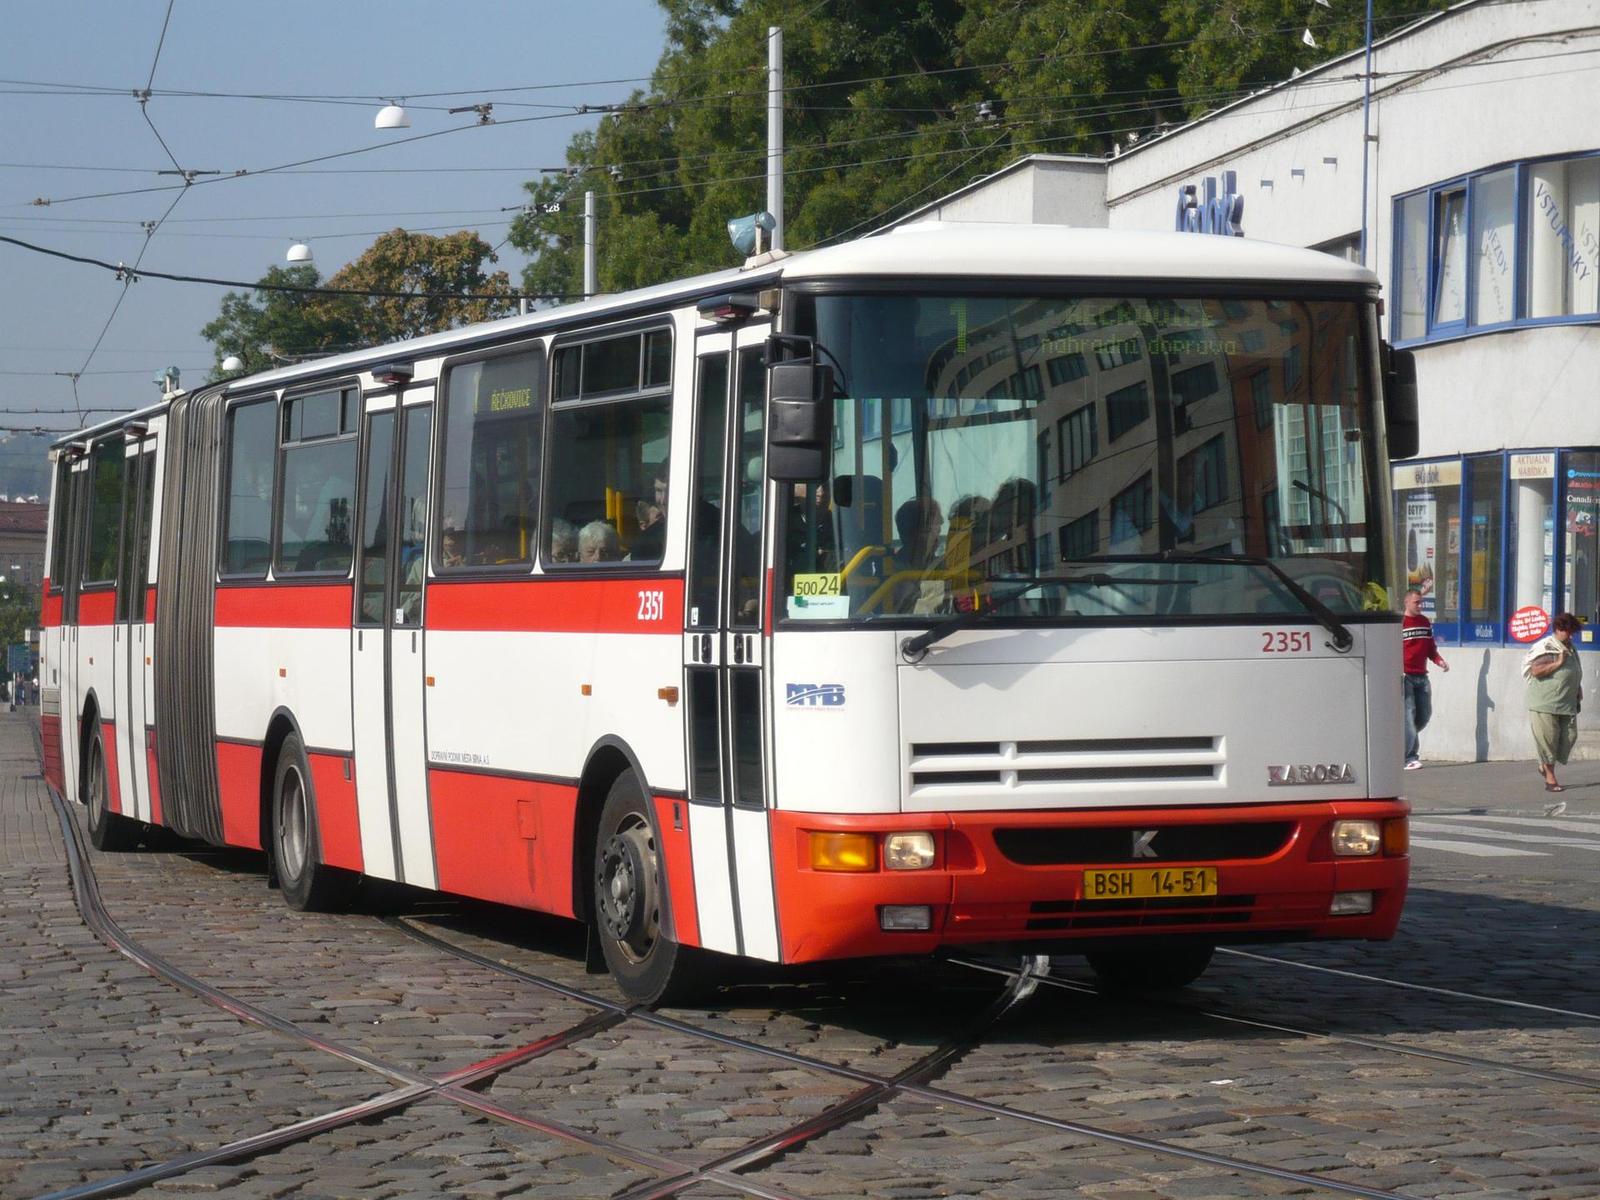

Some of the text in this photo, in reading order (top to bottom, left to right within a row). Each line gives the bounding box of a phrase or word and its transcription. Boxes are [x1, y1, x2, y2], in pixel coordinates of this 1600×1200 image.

[950, 302, 968, 354] 1
[796, 575, 839, 596] 500 24
[637, 590, 664, 621] 2351
[1262, 631, 1312, 652] 2351
[1267, 763, 1355, 786] KAROSA
[1131, 830, 1159, 857] K
[1094, 869, 1206, 895] BSH 14-51
